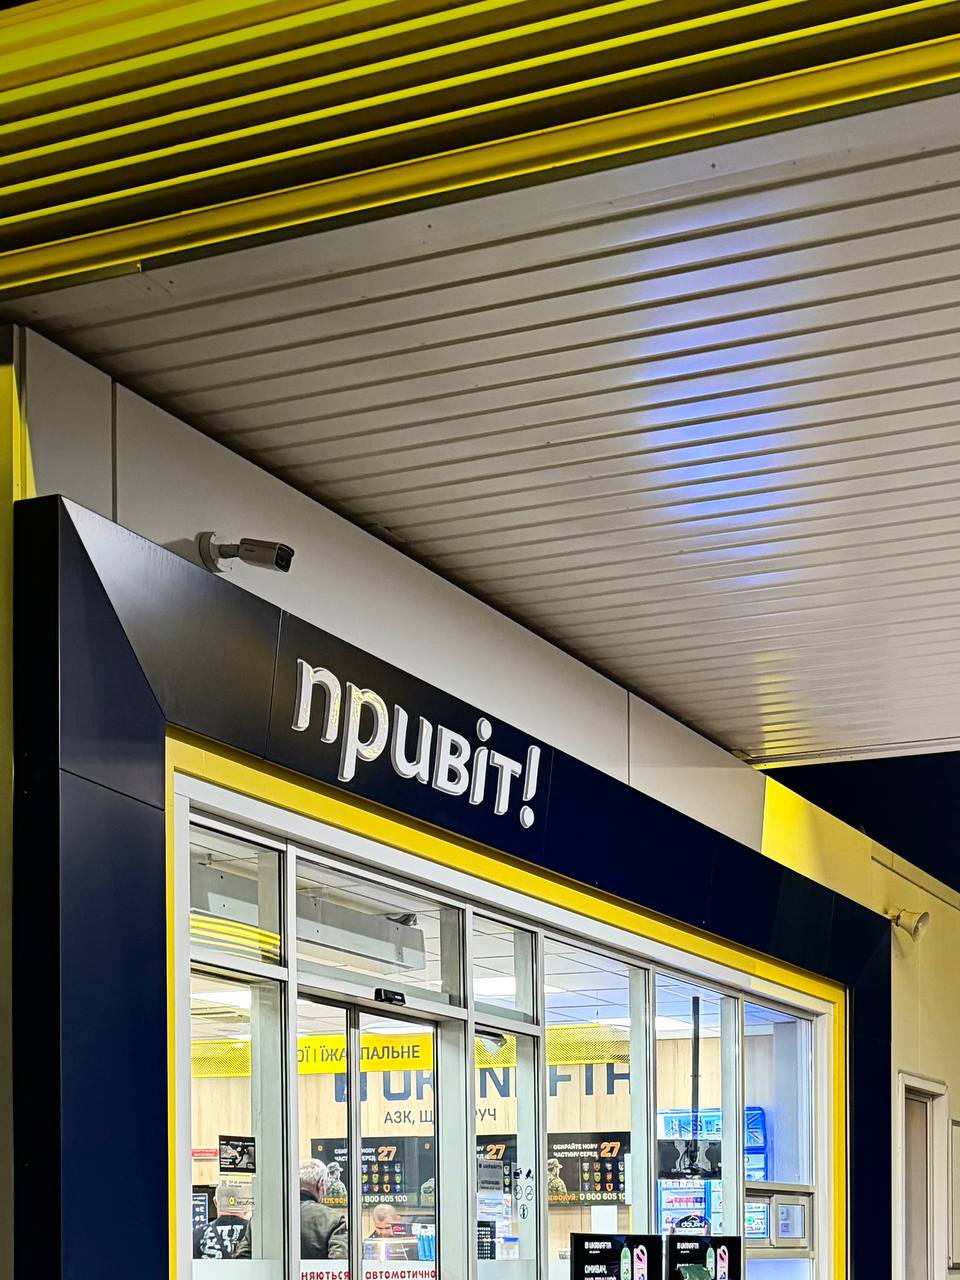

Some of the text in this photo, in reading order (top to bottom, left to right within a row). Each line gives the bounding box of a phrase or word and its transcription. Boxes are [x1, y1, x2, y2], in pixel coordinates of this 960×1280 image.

[291, 658, 541, 829] привіт!
[360, 1044, 420, 1061] ПАЛЬНЕ
[378, 1146, 397, 1161] 27
[486, 1144, 506, 1160] 27
[600, 1142, 620, 1158] 27
[301, 1269, 437, 1280] няються автоматично
